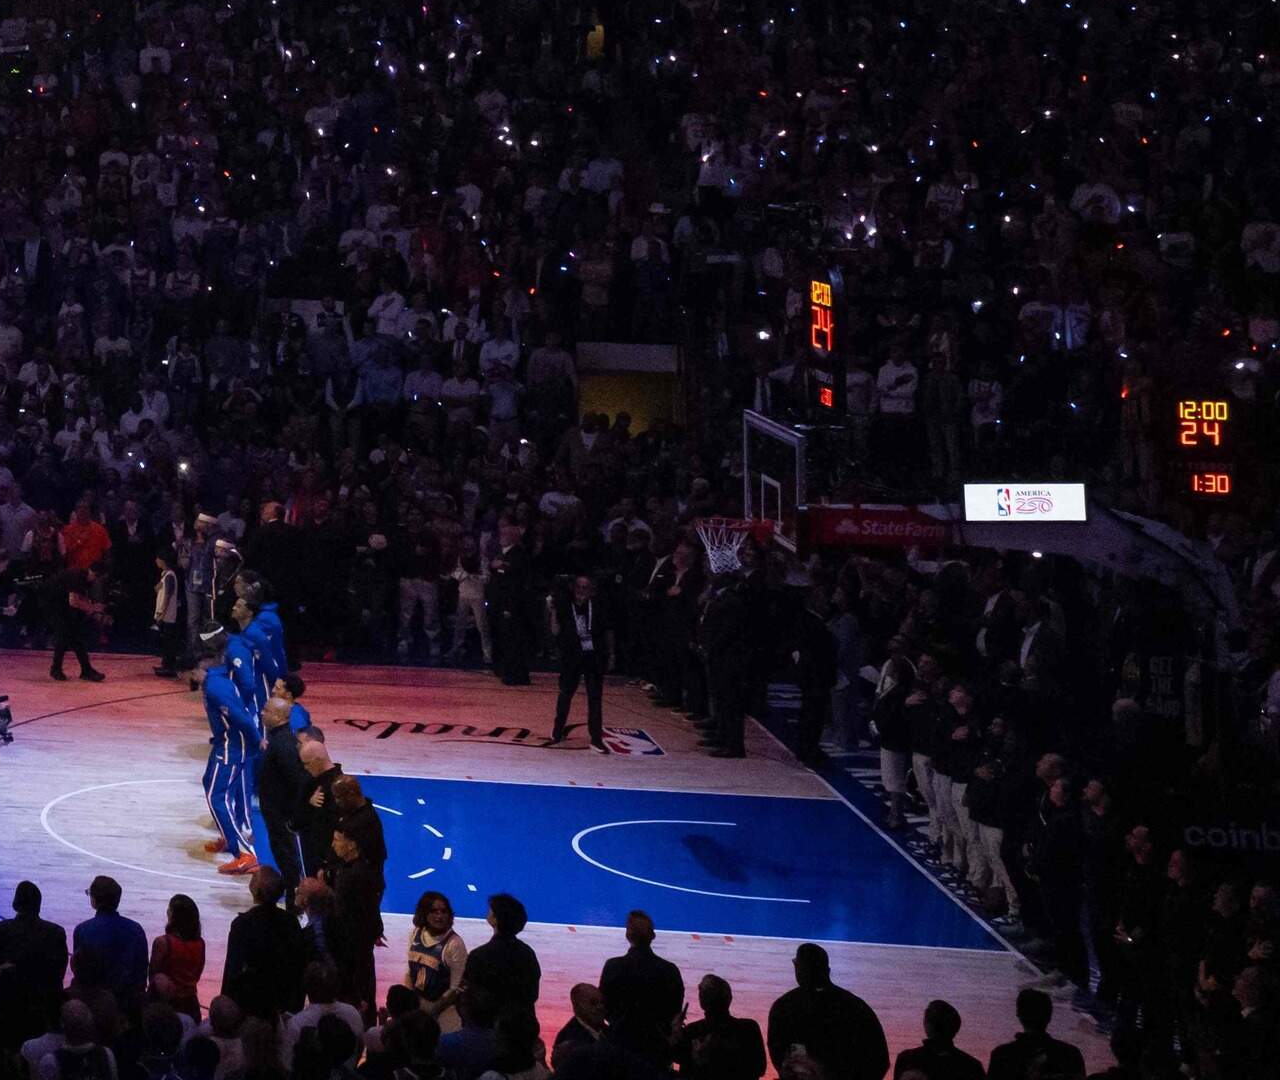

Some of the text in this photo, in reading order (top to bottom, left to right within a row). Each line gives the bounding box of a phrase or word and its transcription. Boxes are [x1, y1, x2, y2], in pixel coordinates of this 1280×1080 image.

[811, 306, 833, 351] 24
[1178, 400, 1229, 422] 12:00
[1180, 422, 1221, 446] 24
[1193, 474, 1230, 495] 1:30
[1015, 497, 1054, 514] 250
